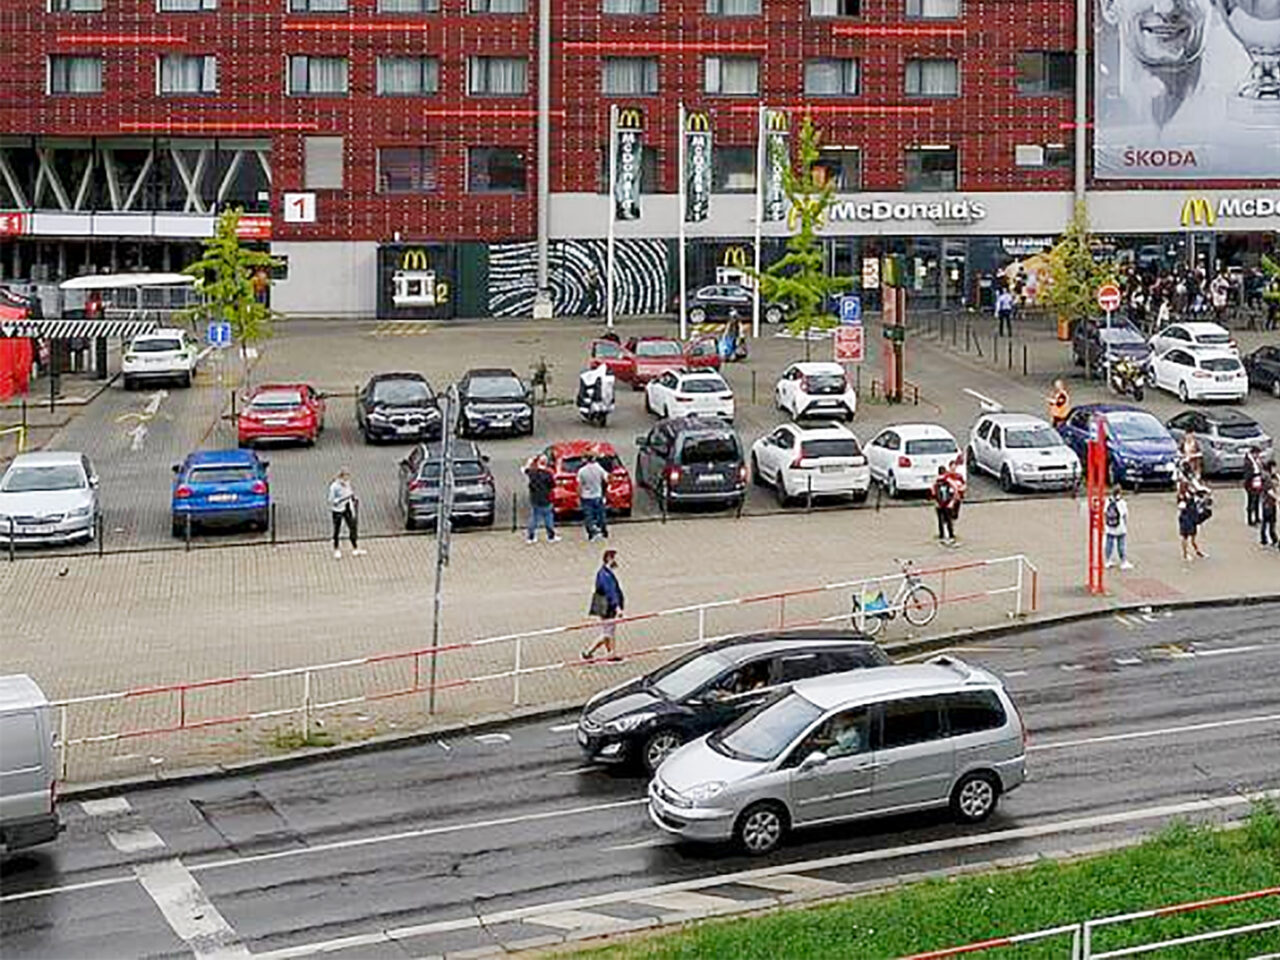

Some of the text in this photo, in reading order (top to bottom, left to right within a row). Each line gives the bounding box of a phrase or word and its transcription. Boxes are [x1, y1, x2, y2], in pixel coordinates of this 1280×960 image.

[1123, 146, 1198, 167] ŠKODA
[292, 198, 306, 220] 1
[829, 200, 987, 220] McDonald's
